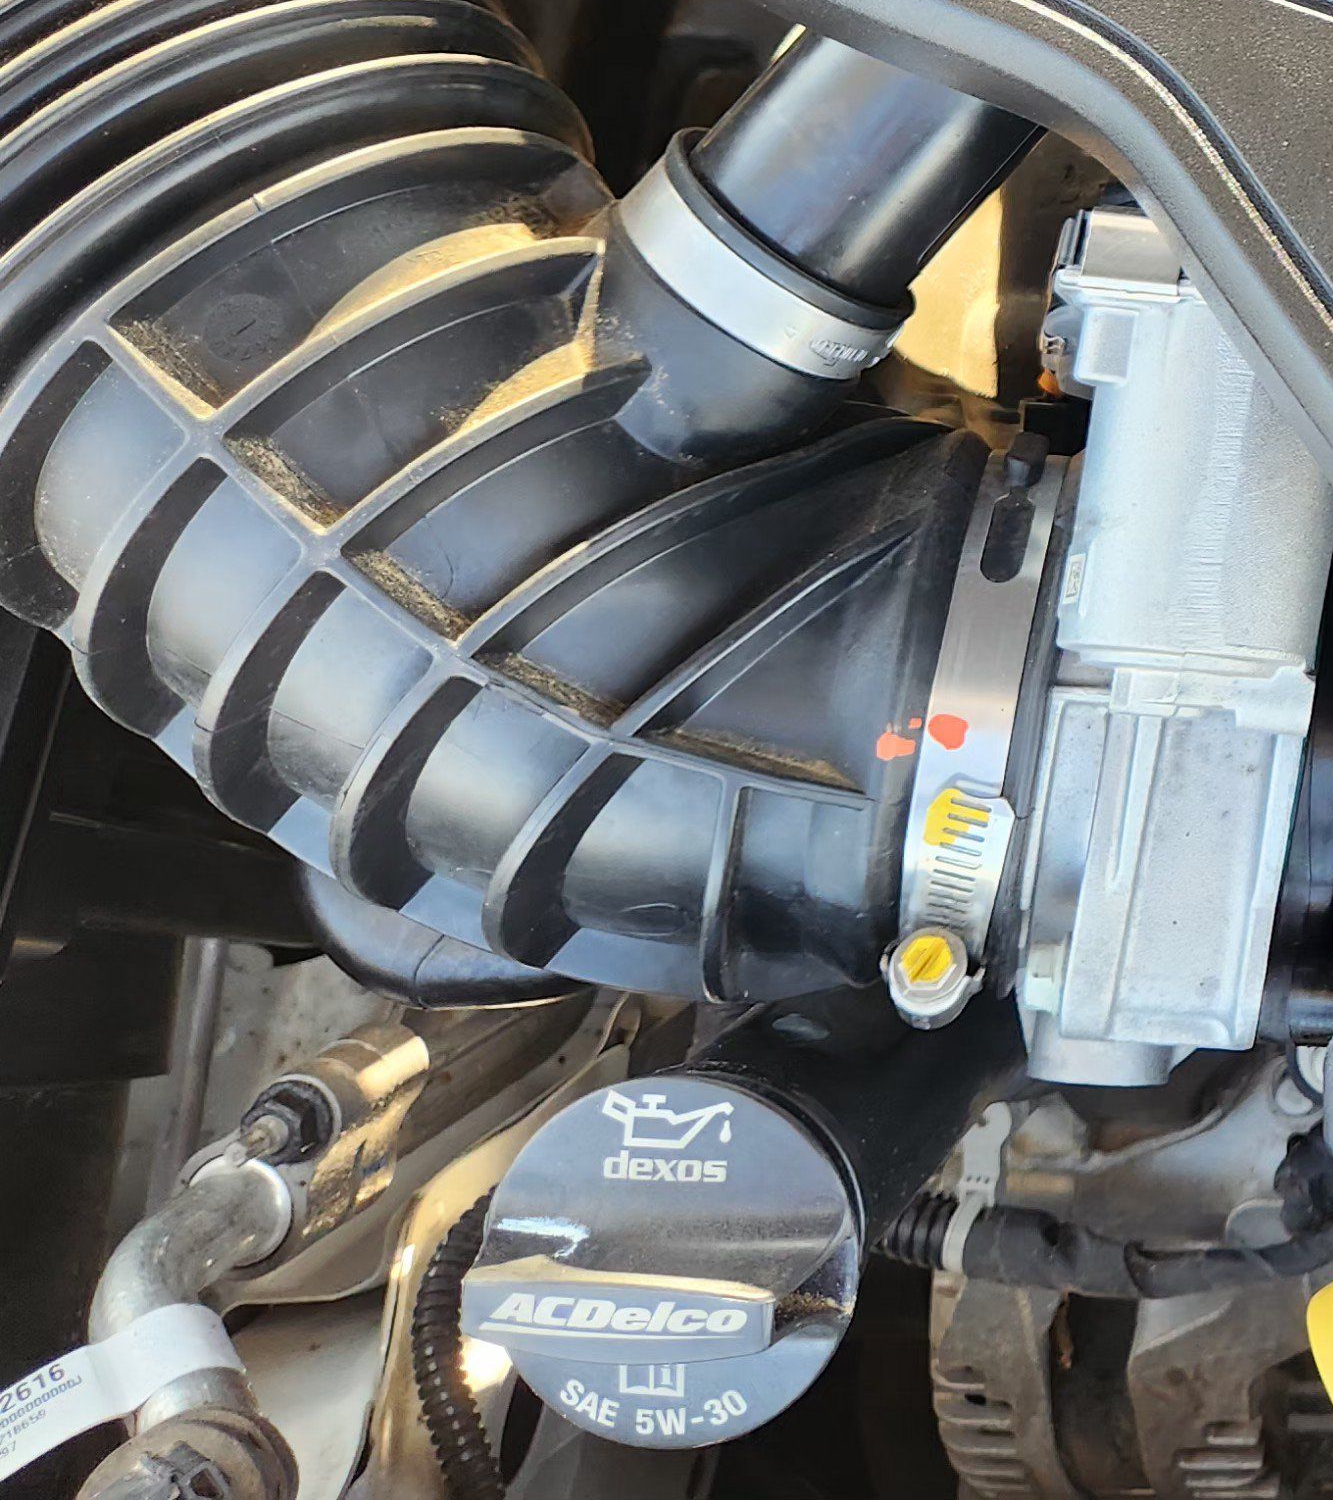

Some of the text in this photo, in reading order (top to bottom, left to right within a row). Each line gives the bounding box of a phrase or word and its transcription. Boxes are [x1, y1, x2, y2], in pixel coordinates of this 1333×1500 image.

[602, 1150, 728, 1183] dexos
[489, 1292, 748, 1334] ACDelco
[559, 1379, 748, 1436] SAE 5W-30
